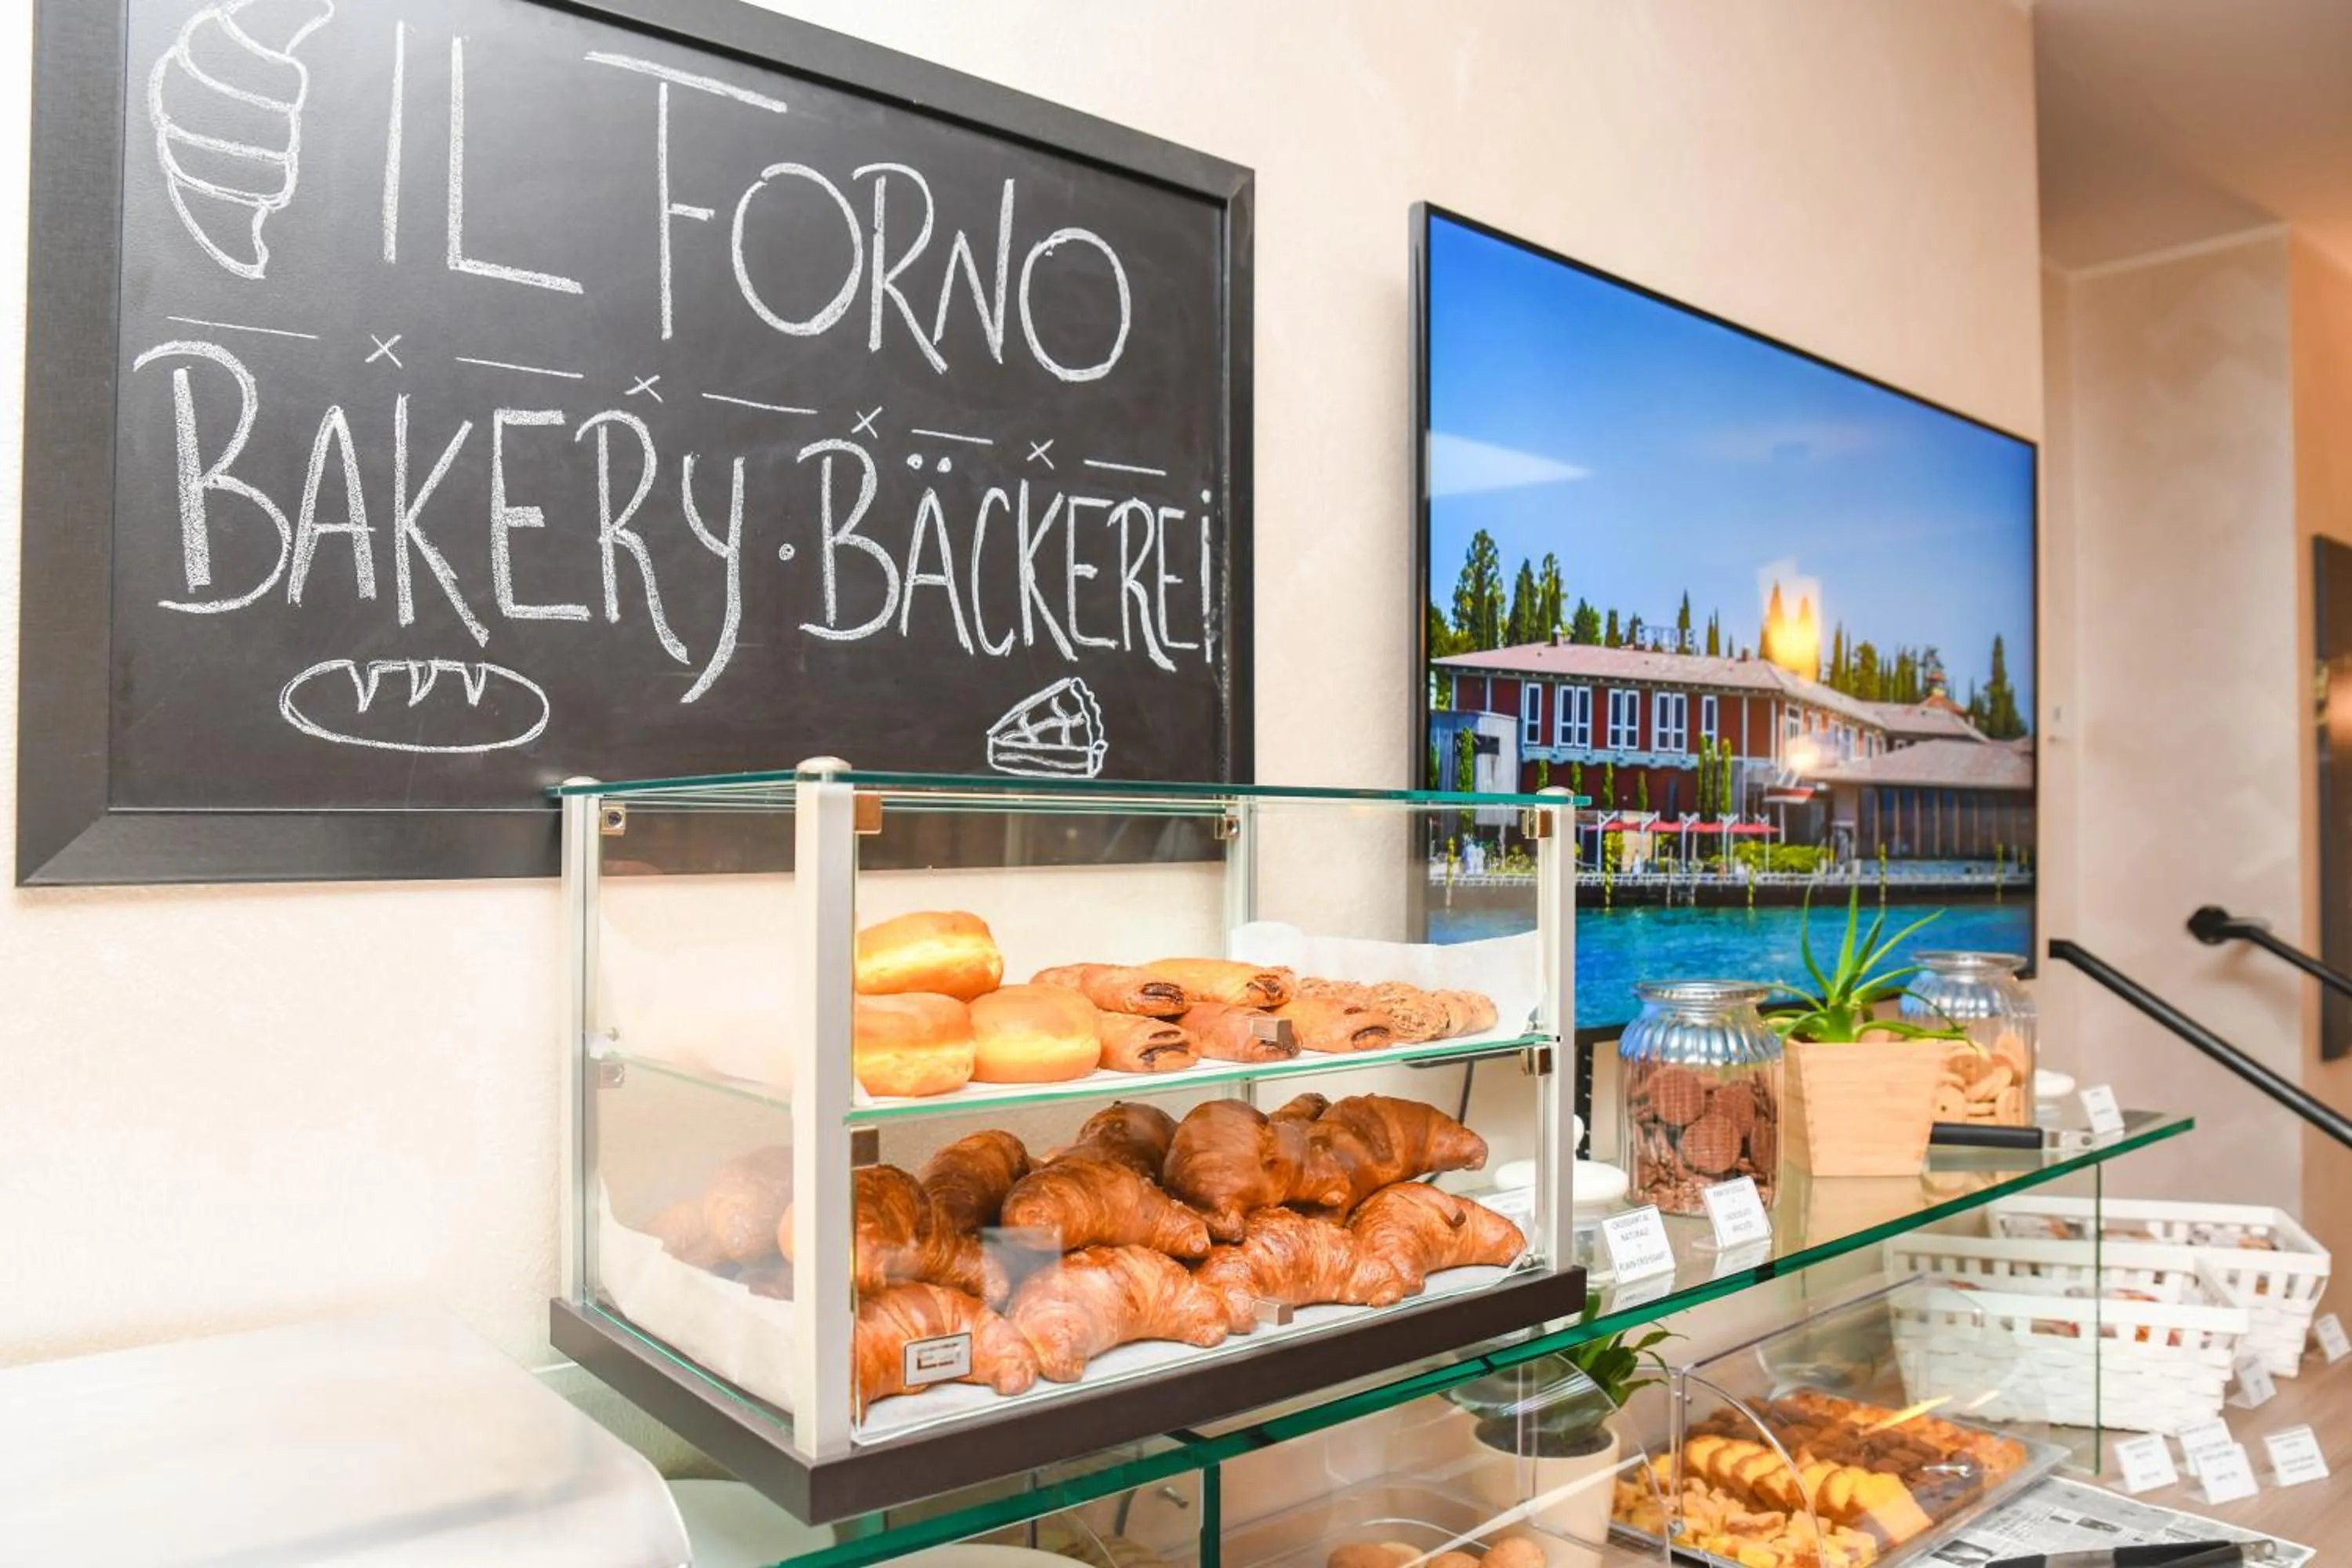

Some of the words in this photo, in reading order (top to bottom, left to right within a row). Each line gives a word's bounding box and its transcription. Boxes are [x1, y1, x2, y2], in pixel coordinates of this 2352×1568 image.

[382, 21, 584, 295] IL
[584, 50, 1132, 383] FORNO
[132, 339, 746, 704] BAKERY
